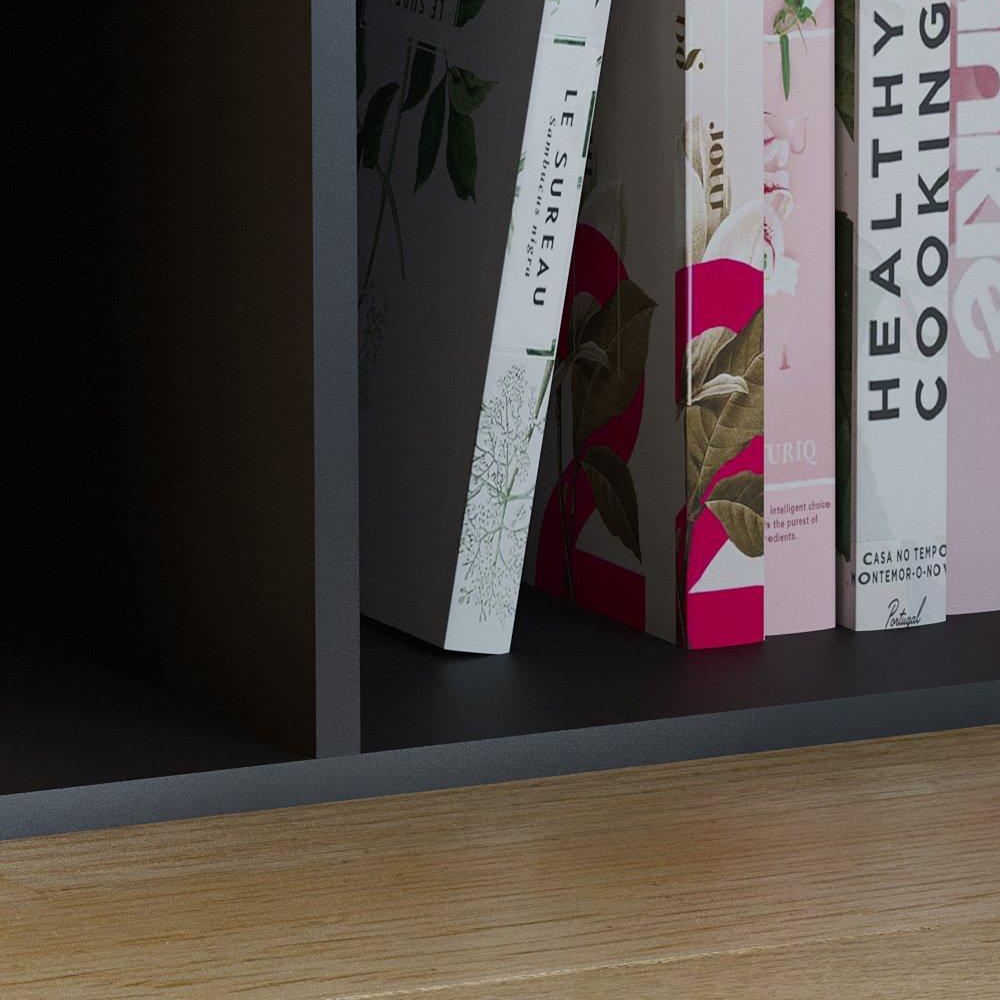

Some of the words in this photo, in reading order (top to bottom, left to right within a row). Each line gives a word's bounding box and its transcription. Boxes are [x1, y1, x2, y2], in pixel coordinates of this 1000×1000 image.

[560, 89, 578, 127] LE
[533, 115, 557, 217] Sambucus
[709, 121, 724, 209] mor
[532, 151, 568, 307] SUREAU
[867, 10, 904, 421] HEALTHY
[915, 1, 951, 421] COOKING
[524, 223, 540, 279] nigra
[770, 502, 806, 516] intelligent
[808, 499, 831, 511] choice
[773, 519, 785, 528] the
[786, 516, 809, 529] purest
[810, 513, 818, 524] of
[862, 550, 893, 566] CASA
[896, 548, 910, 562] NO
[913, 544, 947, 560] TEMPO
[885, 595, 927, 629] Portugal
